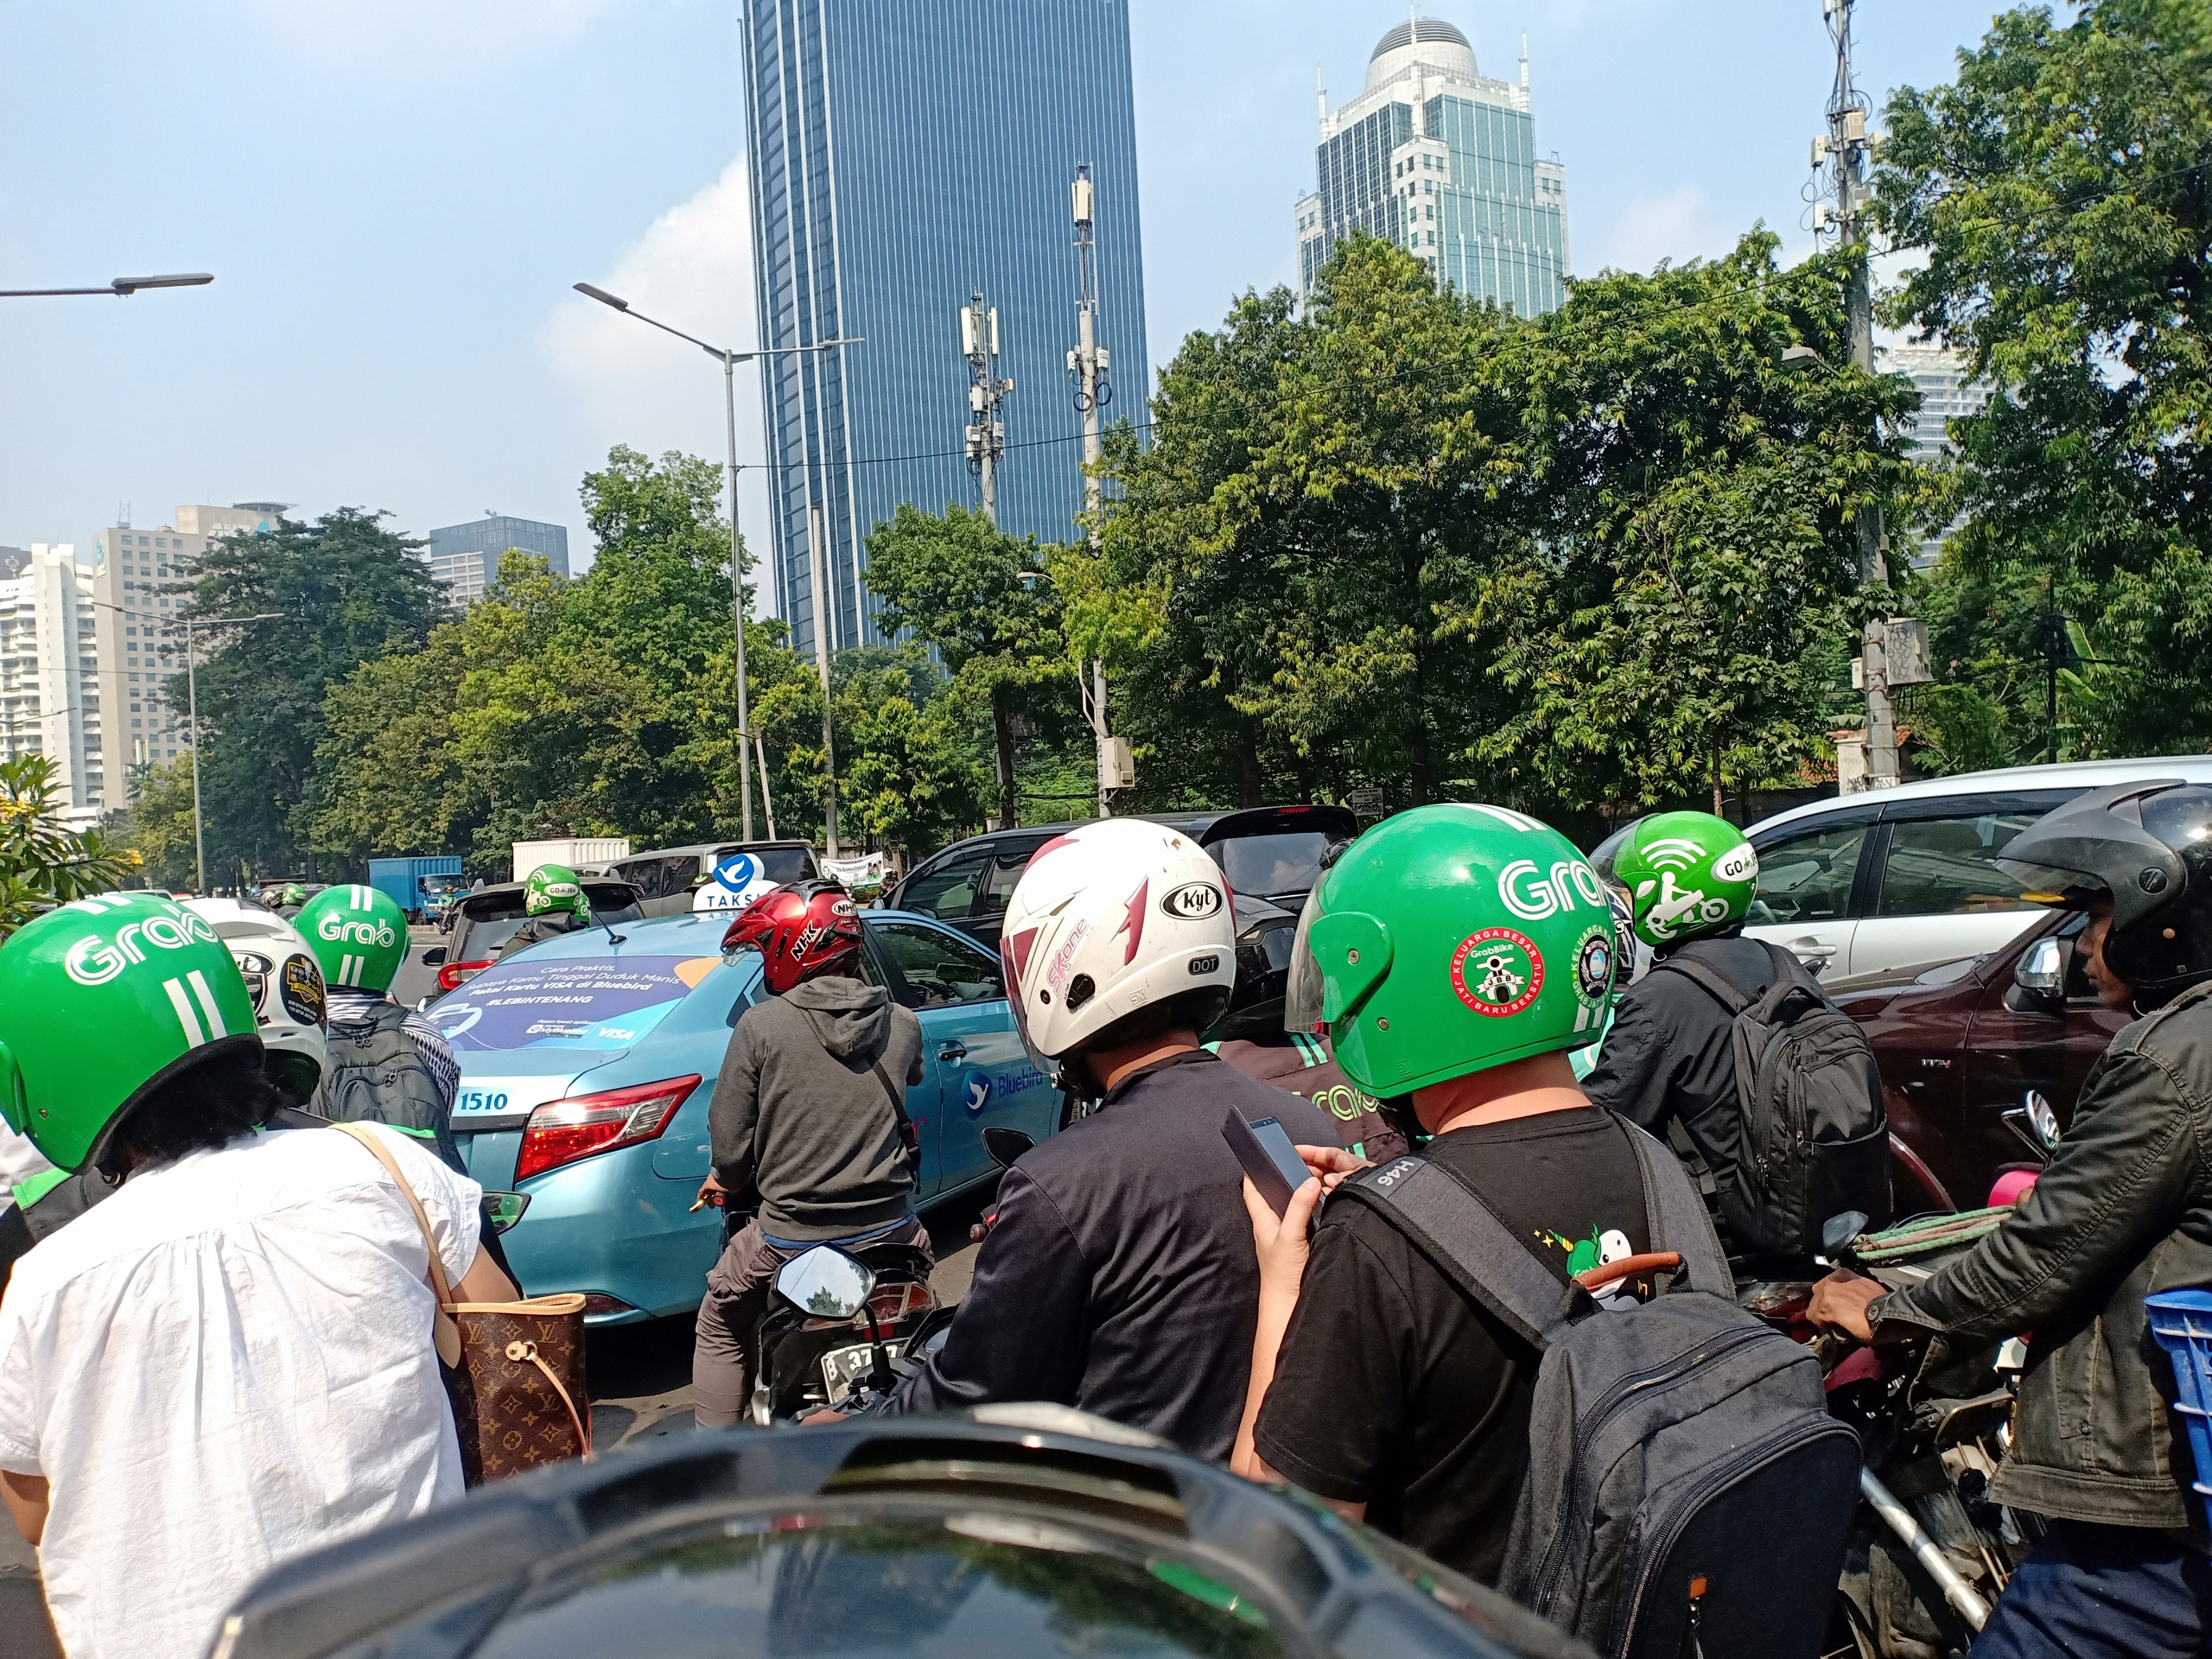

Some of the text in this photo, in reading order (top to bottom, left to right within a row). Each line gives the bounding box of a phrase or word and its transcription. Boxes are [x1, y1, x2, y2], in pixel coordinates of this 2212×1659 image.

[1725, 860, 1743, 876] GO
[1183, 889, 1211, 912] Kyt
[1497, 859, 1607, 921] Gra
[318, 912, 395, 948] Grab
[790, 918, 822, 962] NHK
[65, 903, 218, 986] Grab
[1452, 930, 1537, 974] KELUARGA BESAR
[1470, 944, 1514, 958] GrabBike
[1571, 925, 1603, 970] KELUARGA
[1192, 957, 1217, 973] DOT
[465, 972, 681, 991] Supaya Kamu Tinggal Duduk Manis
[468, 986, 504, 996] Pakai
[503, 983, 540, 992] Kartu
[592, 981, 654, 991] Bluebird
[1454, 963, 1541, 1014] JATI BARU BERSATU
[1573, 981, 1589, 1005] GRAB
[486, 995, 594, 1007] #LEBIHTENANG
[598, 1027, 635, 1041] VISA
[998, 1067, 1043, 1098] Bluebird
[460, 1092, 508, 1110] 1510
[1291, 1084, 1380, 1122] rab
[1377, 1160, 1414, 1186] H46
